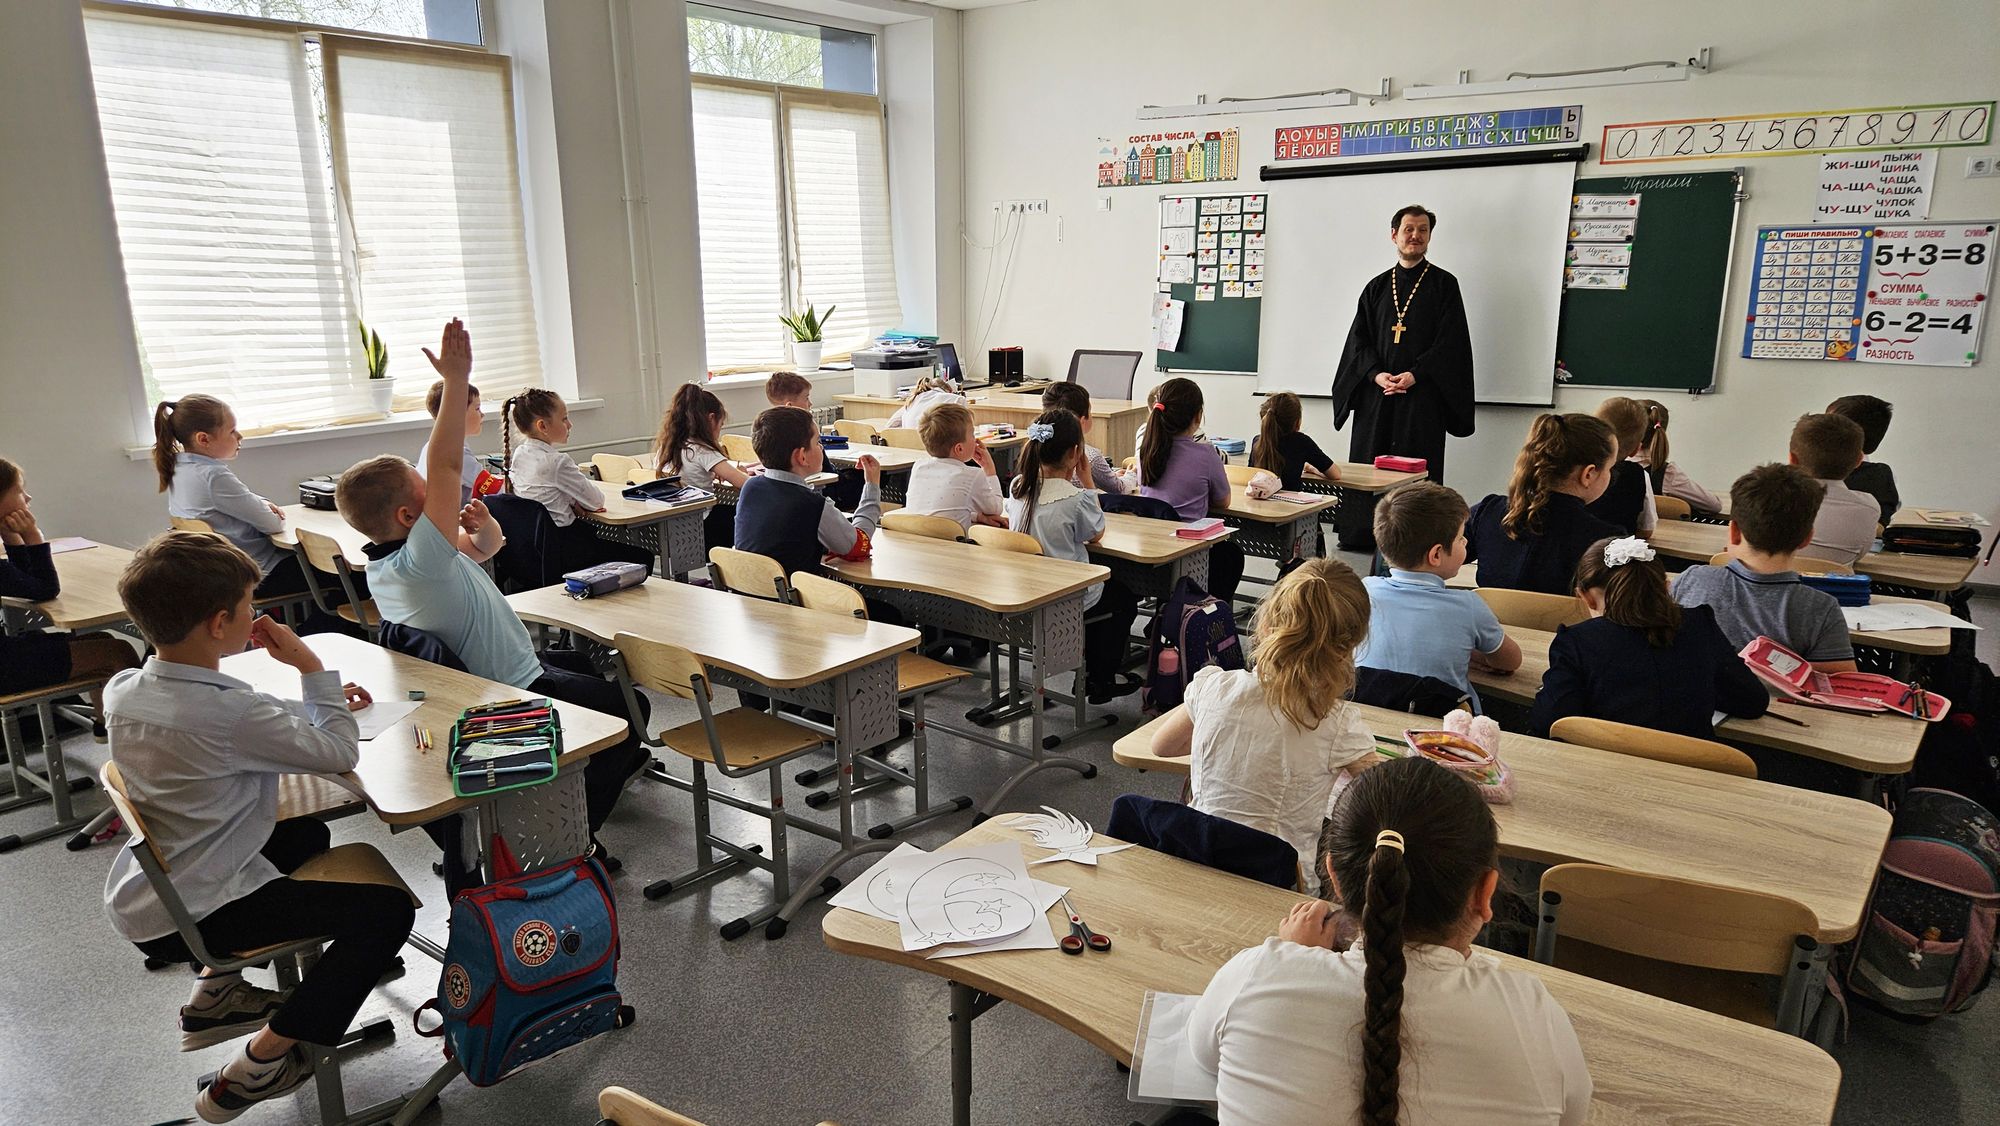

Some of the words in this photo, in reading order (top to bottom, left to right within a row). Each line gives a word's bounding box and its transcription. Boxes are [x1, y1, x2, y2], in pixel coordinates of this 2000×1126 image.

[1128, 134, 1163, 144] СОСТАВ
[1164, 131, 1196, 141] ЧИСЛА
[1824, 159, 1880, 170] ЖИ-ШИ
[1883, 152, 1922, 162] ЛЫЖИ
[1881, 164, 1920, 173] ШИНА
[1880, 175, 1917, 185] ЧАЩА
[1822, 182, 1876, 192] ЧА-ЩА
[1876, 186, 1923, 195] ЧАШКА
[1876, 198, 1916, 207] ЧУЛОК
[1819, 205, 1873, 214] ЧУ-ЩУ
[1874, 210, 1911, 219] ЩУКА
[1583, 222, 1611, 232] Русский
[1811, 230, 1859, 238] ПРАВИЛЬНО
[1875, 243, 1986, 266] 5+3=8
[1881, 284, 1924, 293] СУММА
[1865, 311, 1973, 334] 6-2=4
[1866, 350, 1914, 360] РАЗНОСТЬ
